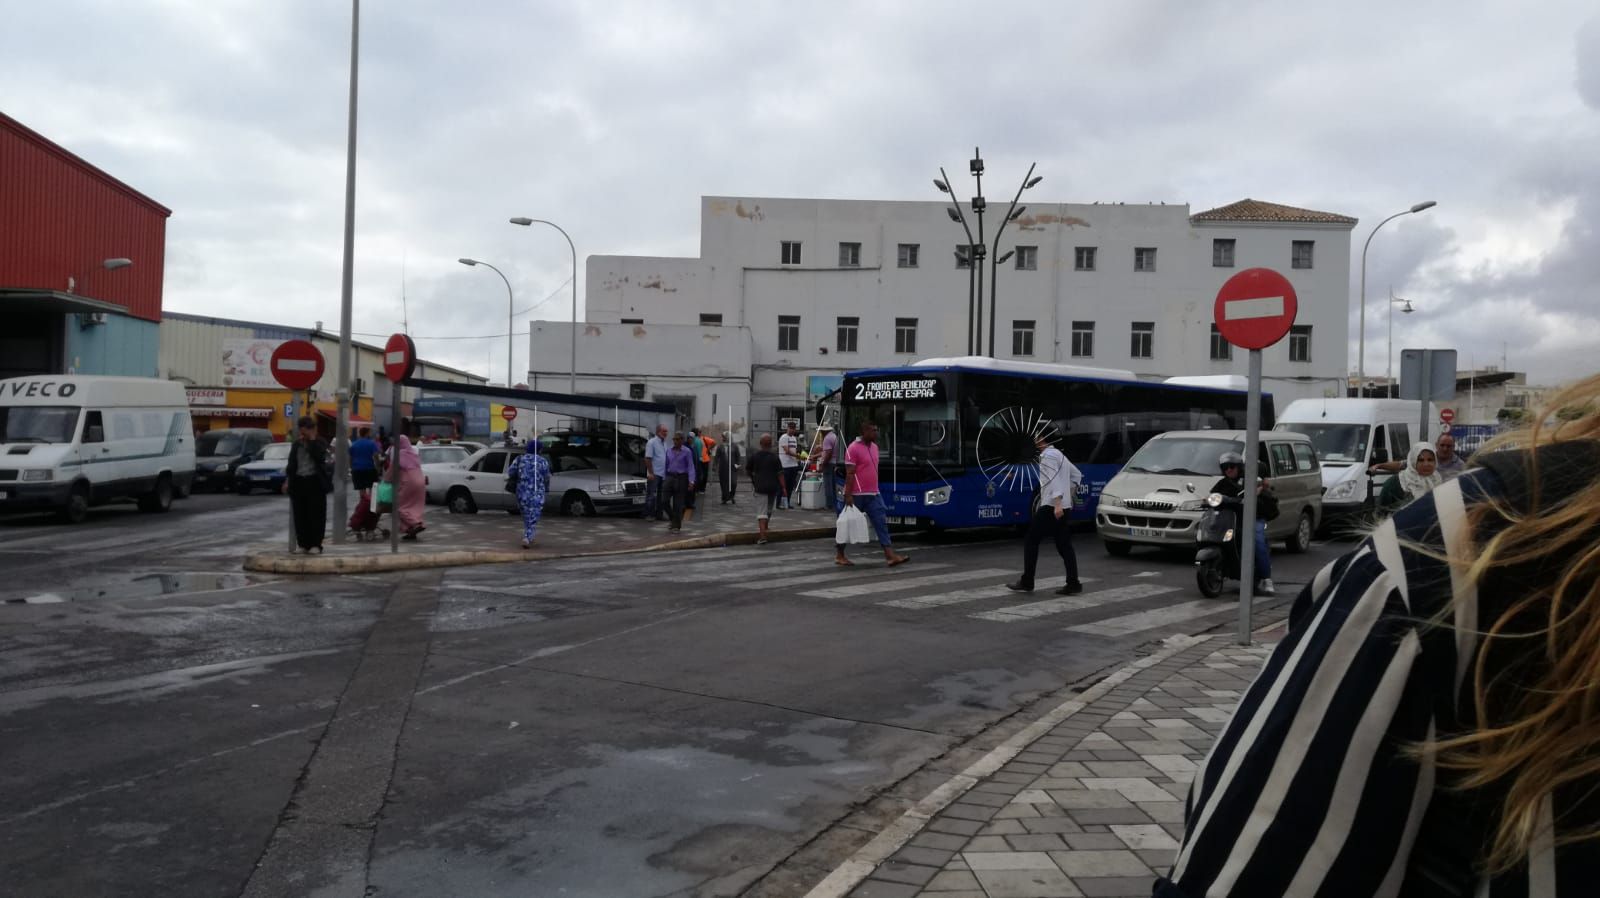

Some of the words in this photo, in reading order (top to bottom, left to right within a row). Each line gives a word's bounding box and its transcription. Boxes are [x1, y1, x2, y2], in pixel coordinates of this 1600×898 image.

[0, 382, 76, 397] IVECO
[867, 381, 900, 390] FRONTERA
[855, 383, 865, 400] 2
[865, 391, 891, 399] PLAZA
[892, 389, 904, 398] DE
[978, 508, 1003, 518] MELILLA
